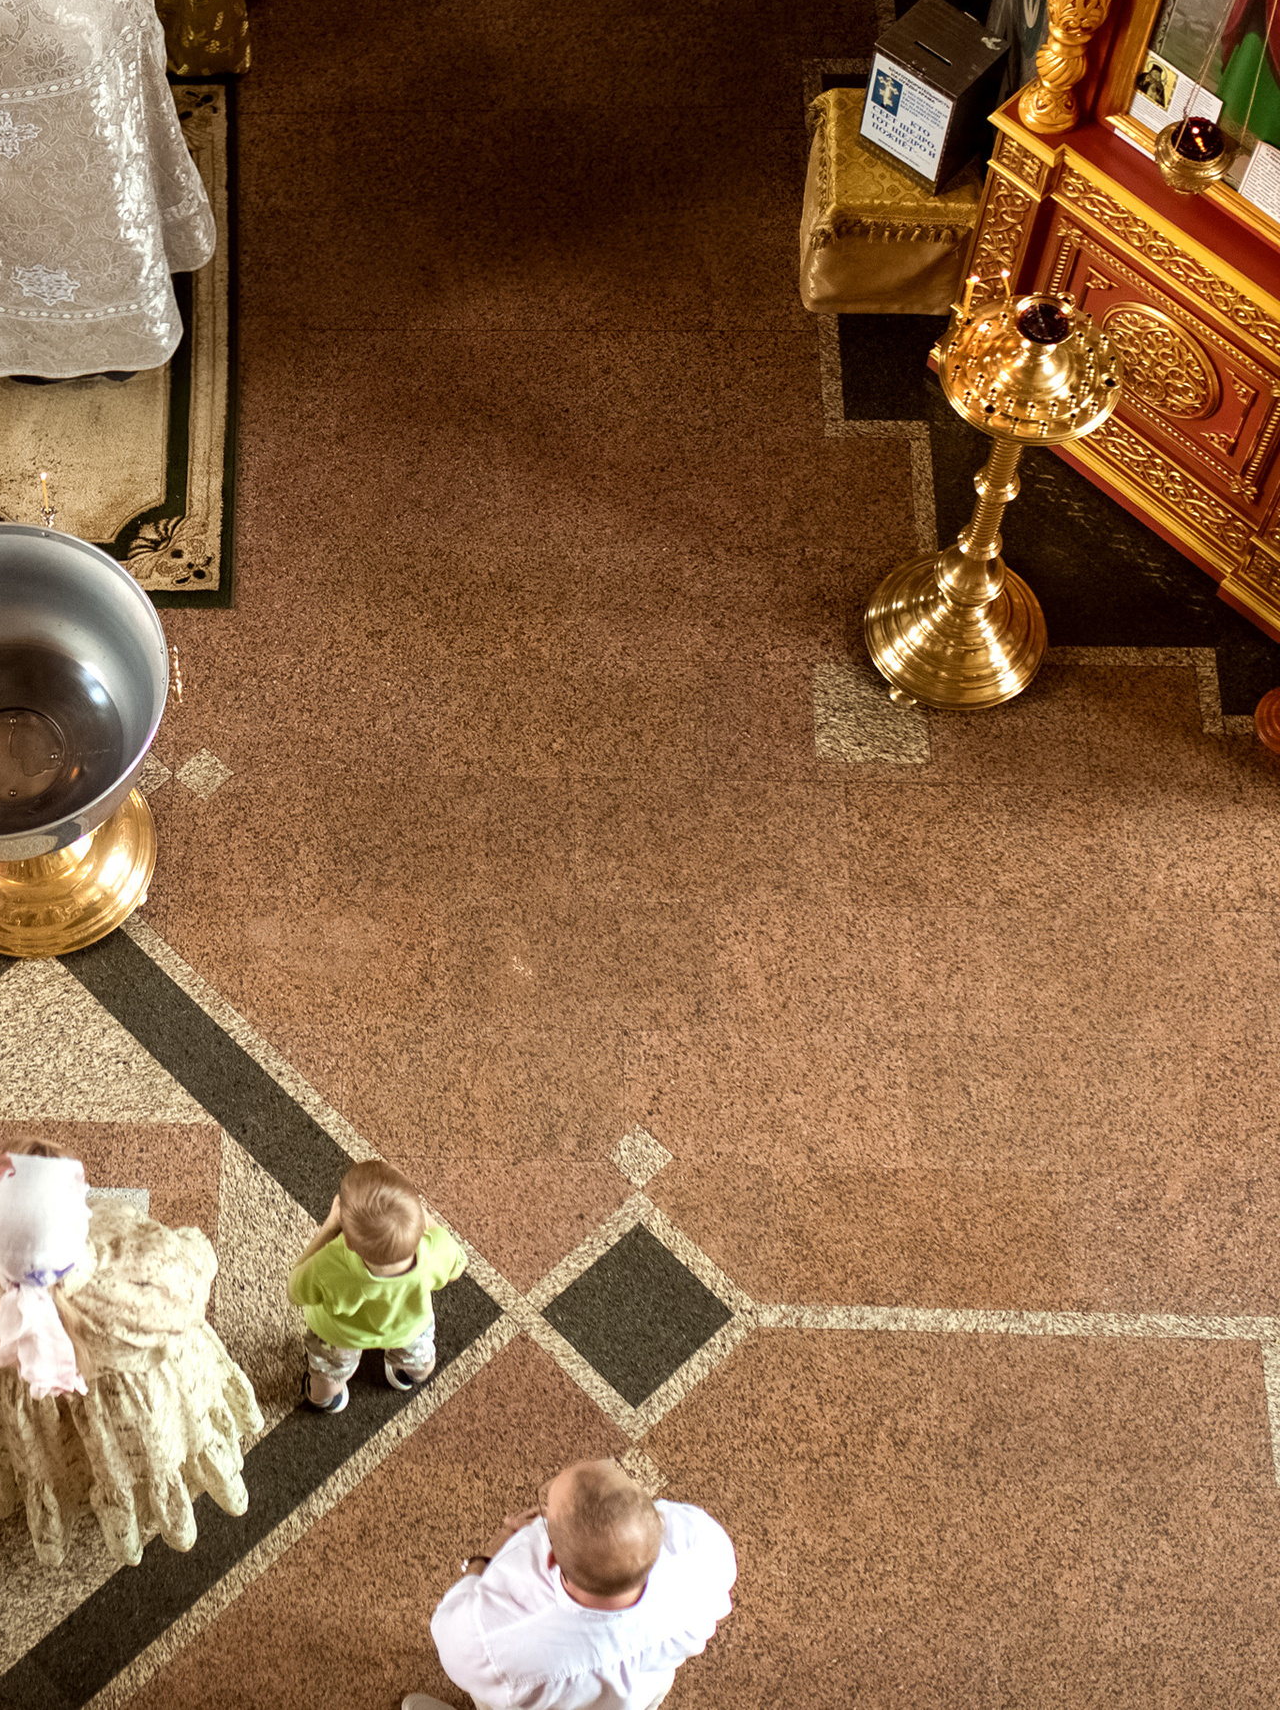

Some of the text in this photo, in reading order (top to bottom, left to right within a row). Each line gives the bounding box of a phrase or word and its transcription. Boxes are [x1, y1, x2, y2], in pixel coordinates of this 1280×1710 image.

[871, 111, 888, 127] ТОТ
[892, 126, 926, 152] ЩЕДРО
[873, 105, 898, 123] СЕЕТ
[900, 122, 936, 151] ЩЕДРО,
[910, 121, 930, 137] КТО
